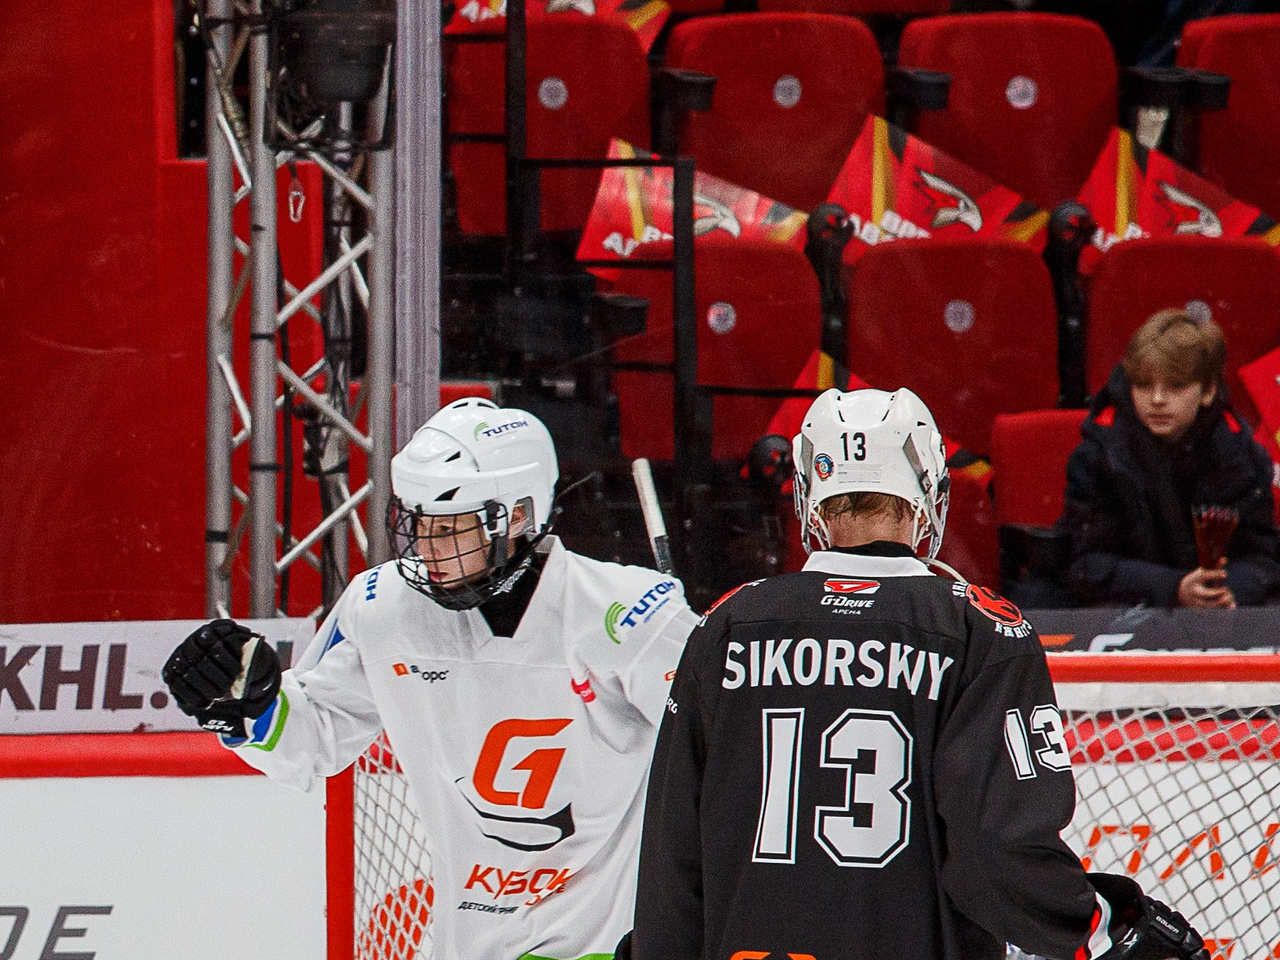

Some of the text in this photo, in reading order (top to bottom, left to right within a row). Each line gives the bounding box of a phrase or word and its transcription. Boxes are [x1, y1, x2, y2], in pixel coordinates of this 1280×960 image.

[840, 432, 866, 461] 13
[722, 638, 954, 700] SIKORSKIY
[1004, 704, 1071, 780] 13
[751, 708, 914, 868] 13
